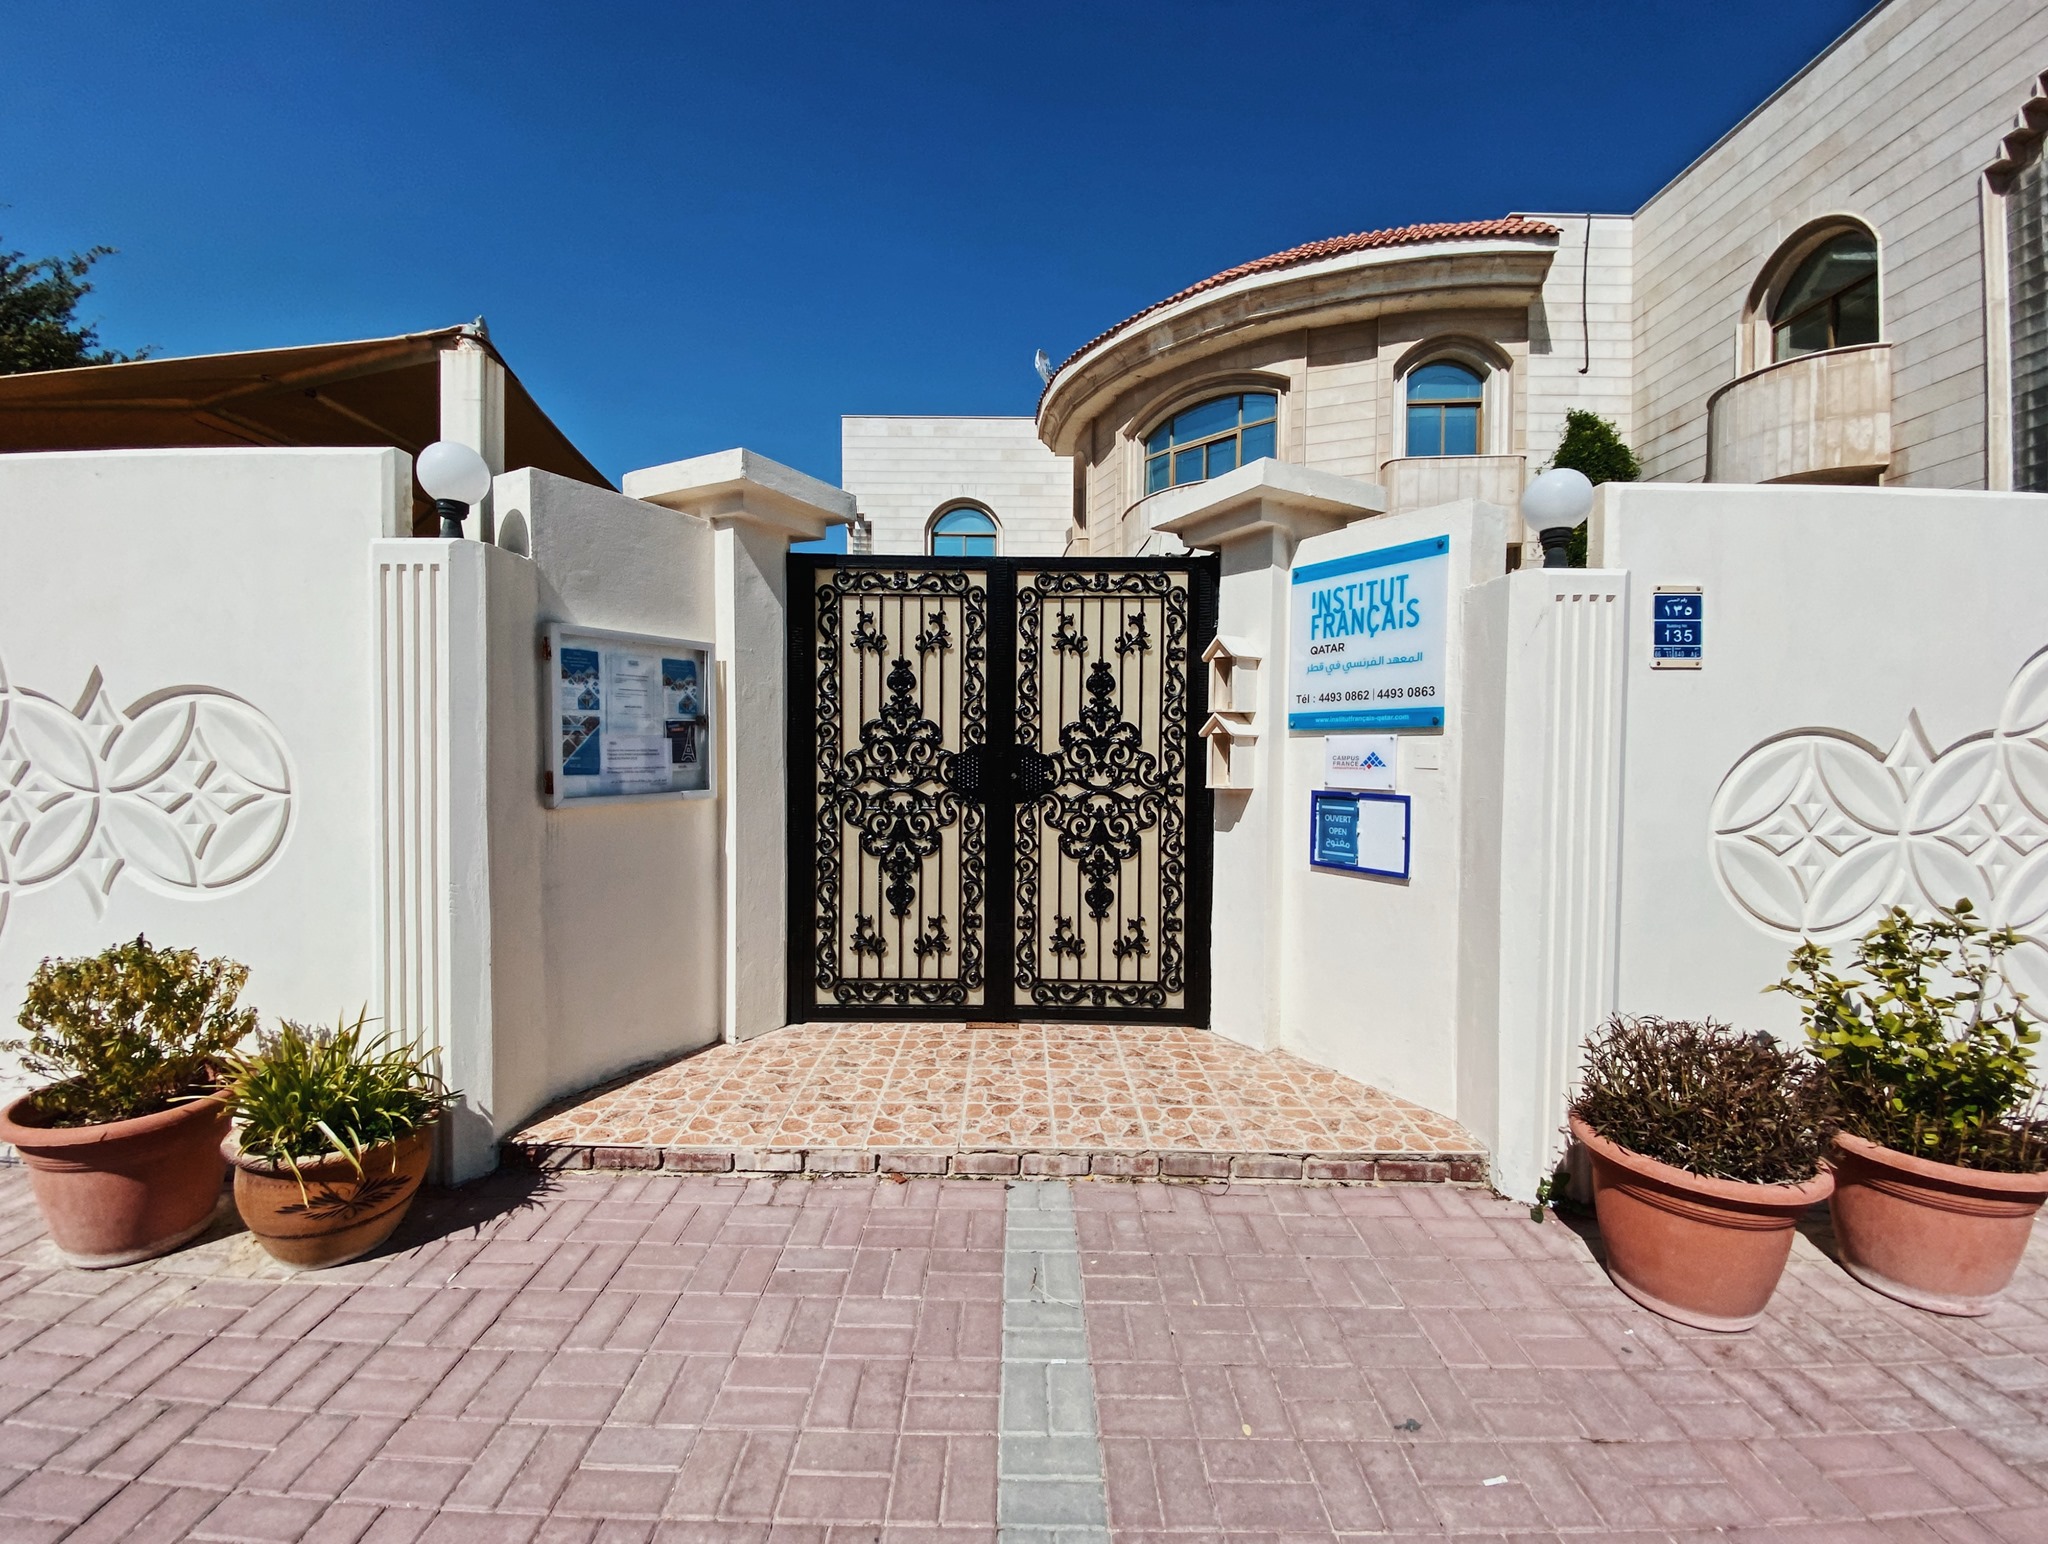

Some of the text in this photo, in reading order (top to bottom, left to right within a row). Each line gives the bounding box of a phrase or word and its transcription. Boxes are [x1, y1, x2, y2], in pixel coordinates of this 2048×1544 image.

[1312, 574, 1409, 616] INSTITUT
[1664, 605, 1693, 616] ١٣٥
[1311, 598, 1420, 640] FRANÇAIS
[1664, 629, 1693, 642] 135
[1310, 643, 1345, 655] QATAR
[1306, 652, 1423, 675] المعهد الفرنسي في قطر
[1296, 694, 1310, 704] Tél
[1318, 692, 1342, 703] 4493
[1345, 690, 1370, 701] 0862
[1377, 688, 1404, 699] 4493
[1407, 686, 1436, 697] 0863
[1324, 814, 1352, 824] OUVERT
[1328, 827, 1347, 836] OPEN
[1325, 838, 1351, 849] مفتوح
